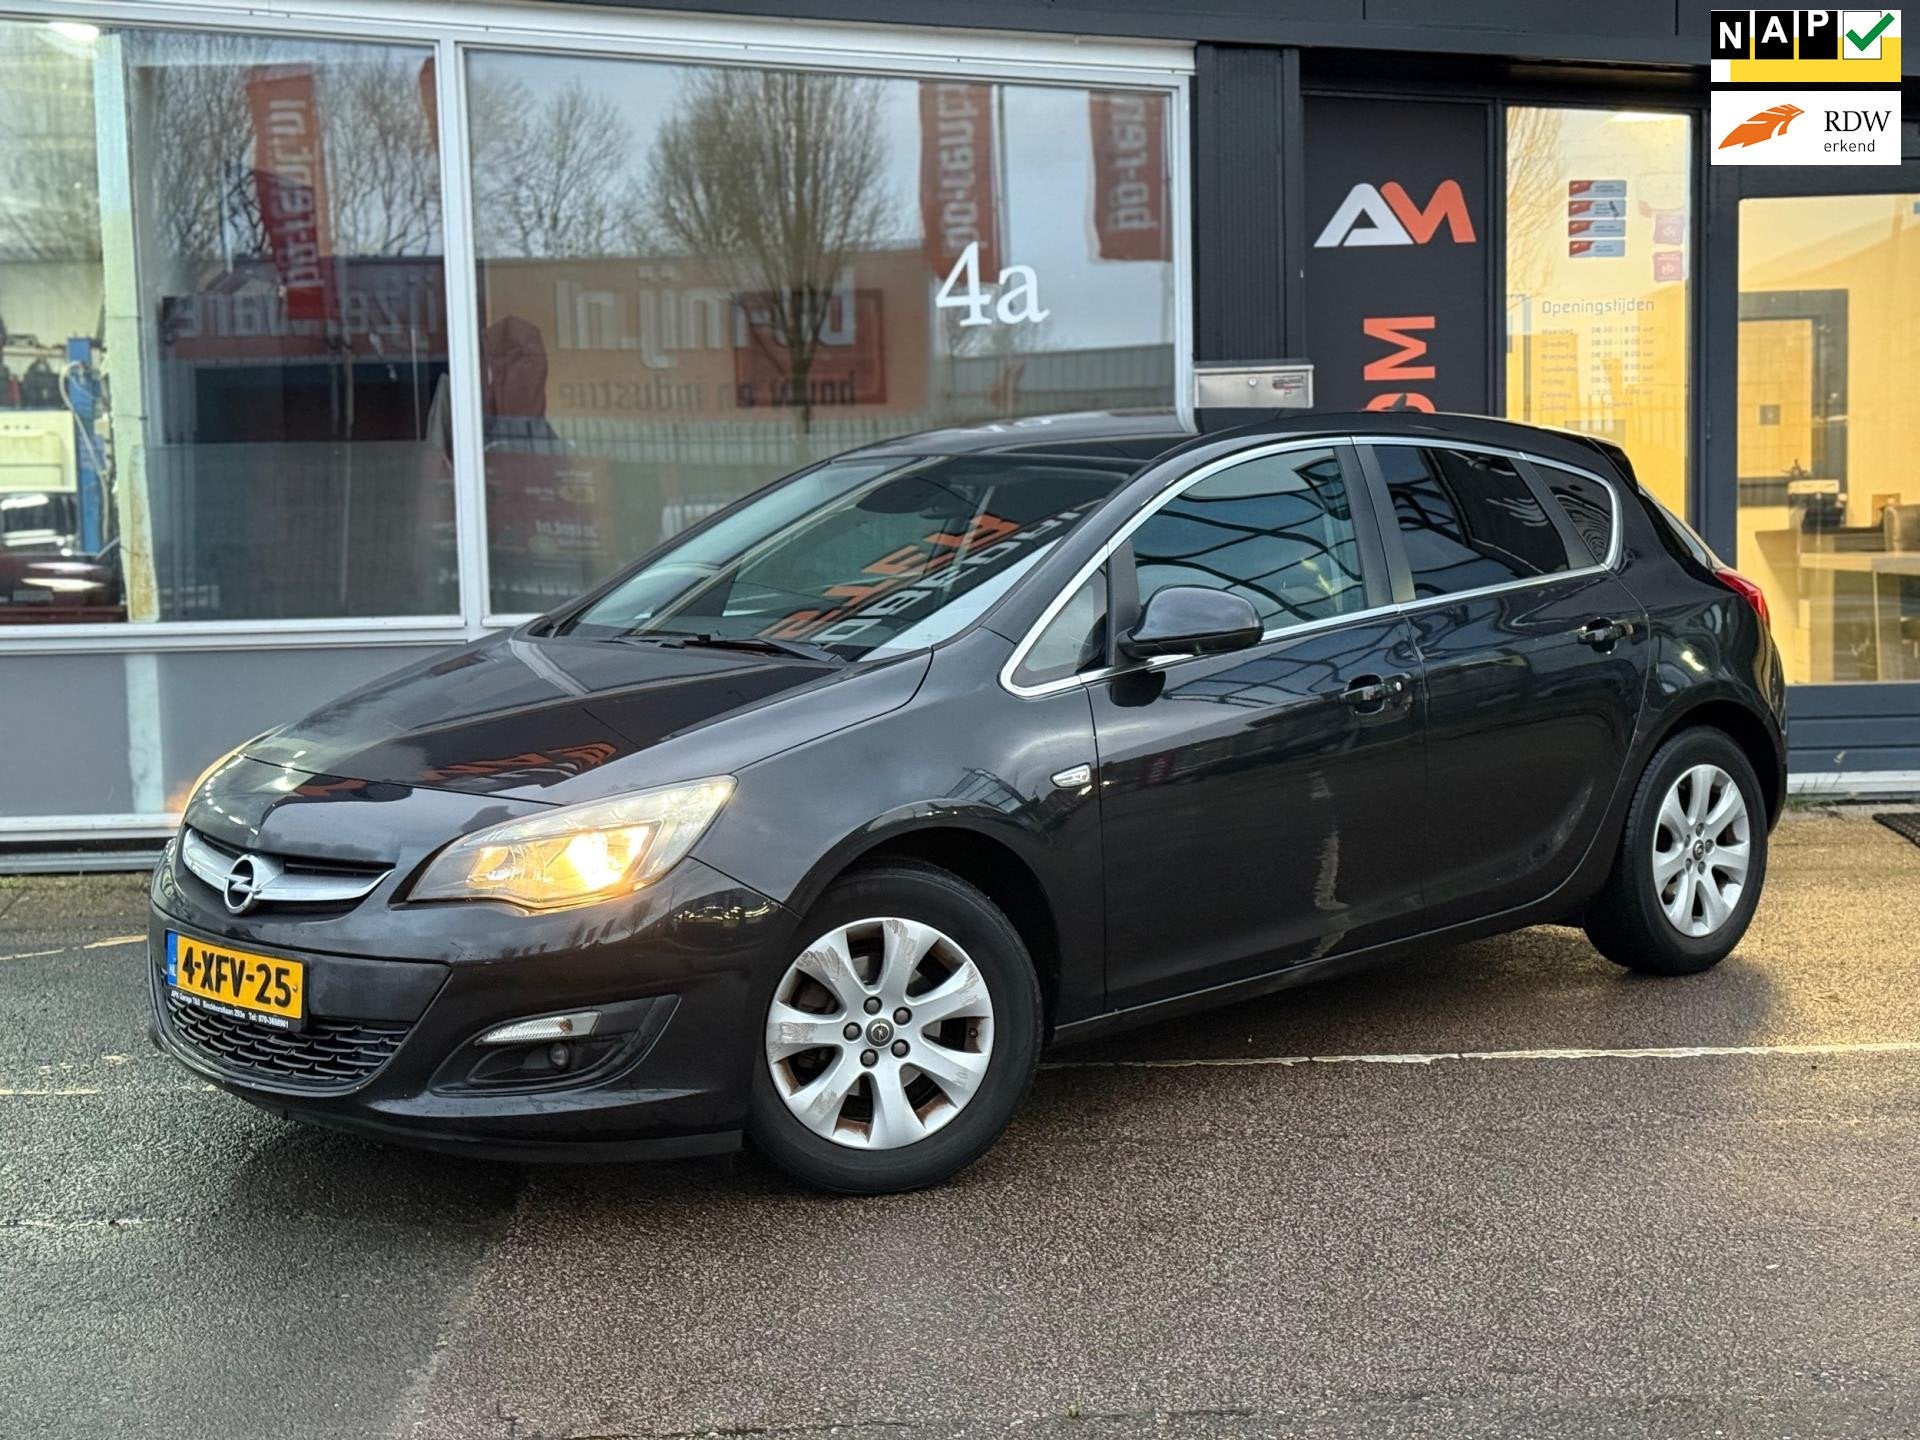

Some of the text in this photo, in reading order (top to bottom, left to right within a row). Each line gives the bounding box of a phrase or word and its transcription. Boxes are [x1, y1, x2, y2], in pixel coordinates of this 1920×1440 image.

[1313, 179, 1477, 247] AM
[935, 241, 1050, 327] 4a
[1542, 298, 1655, 317] Openingstijden
[182, 946, 292, 1008] 4-XFV-25
